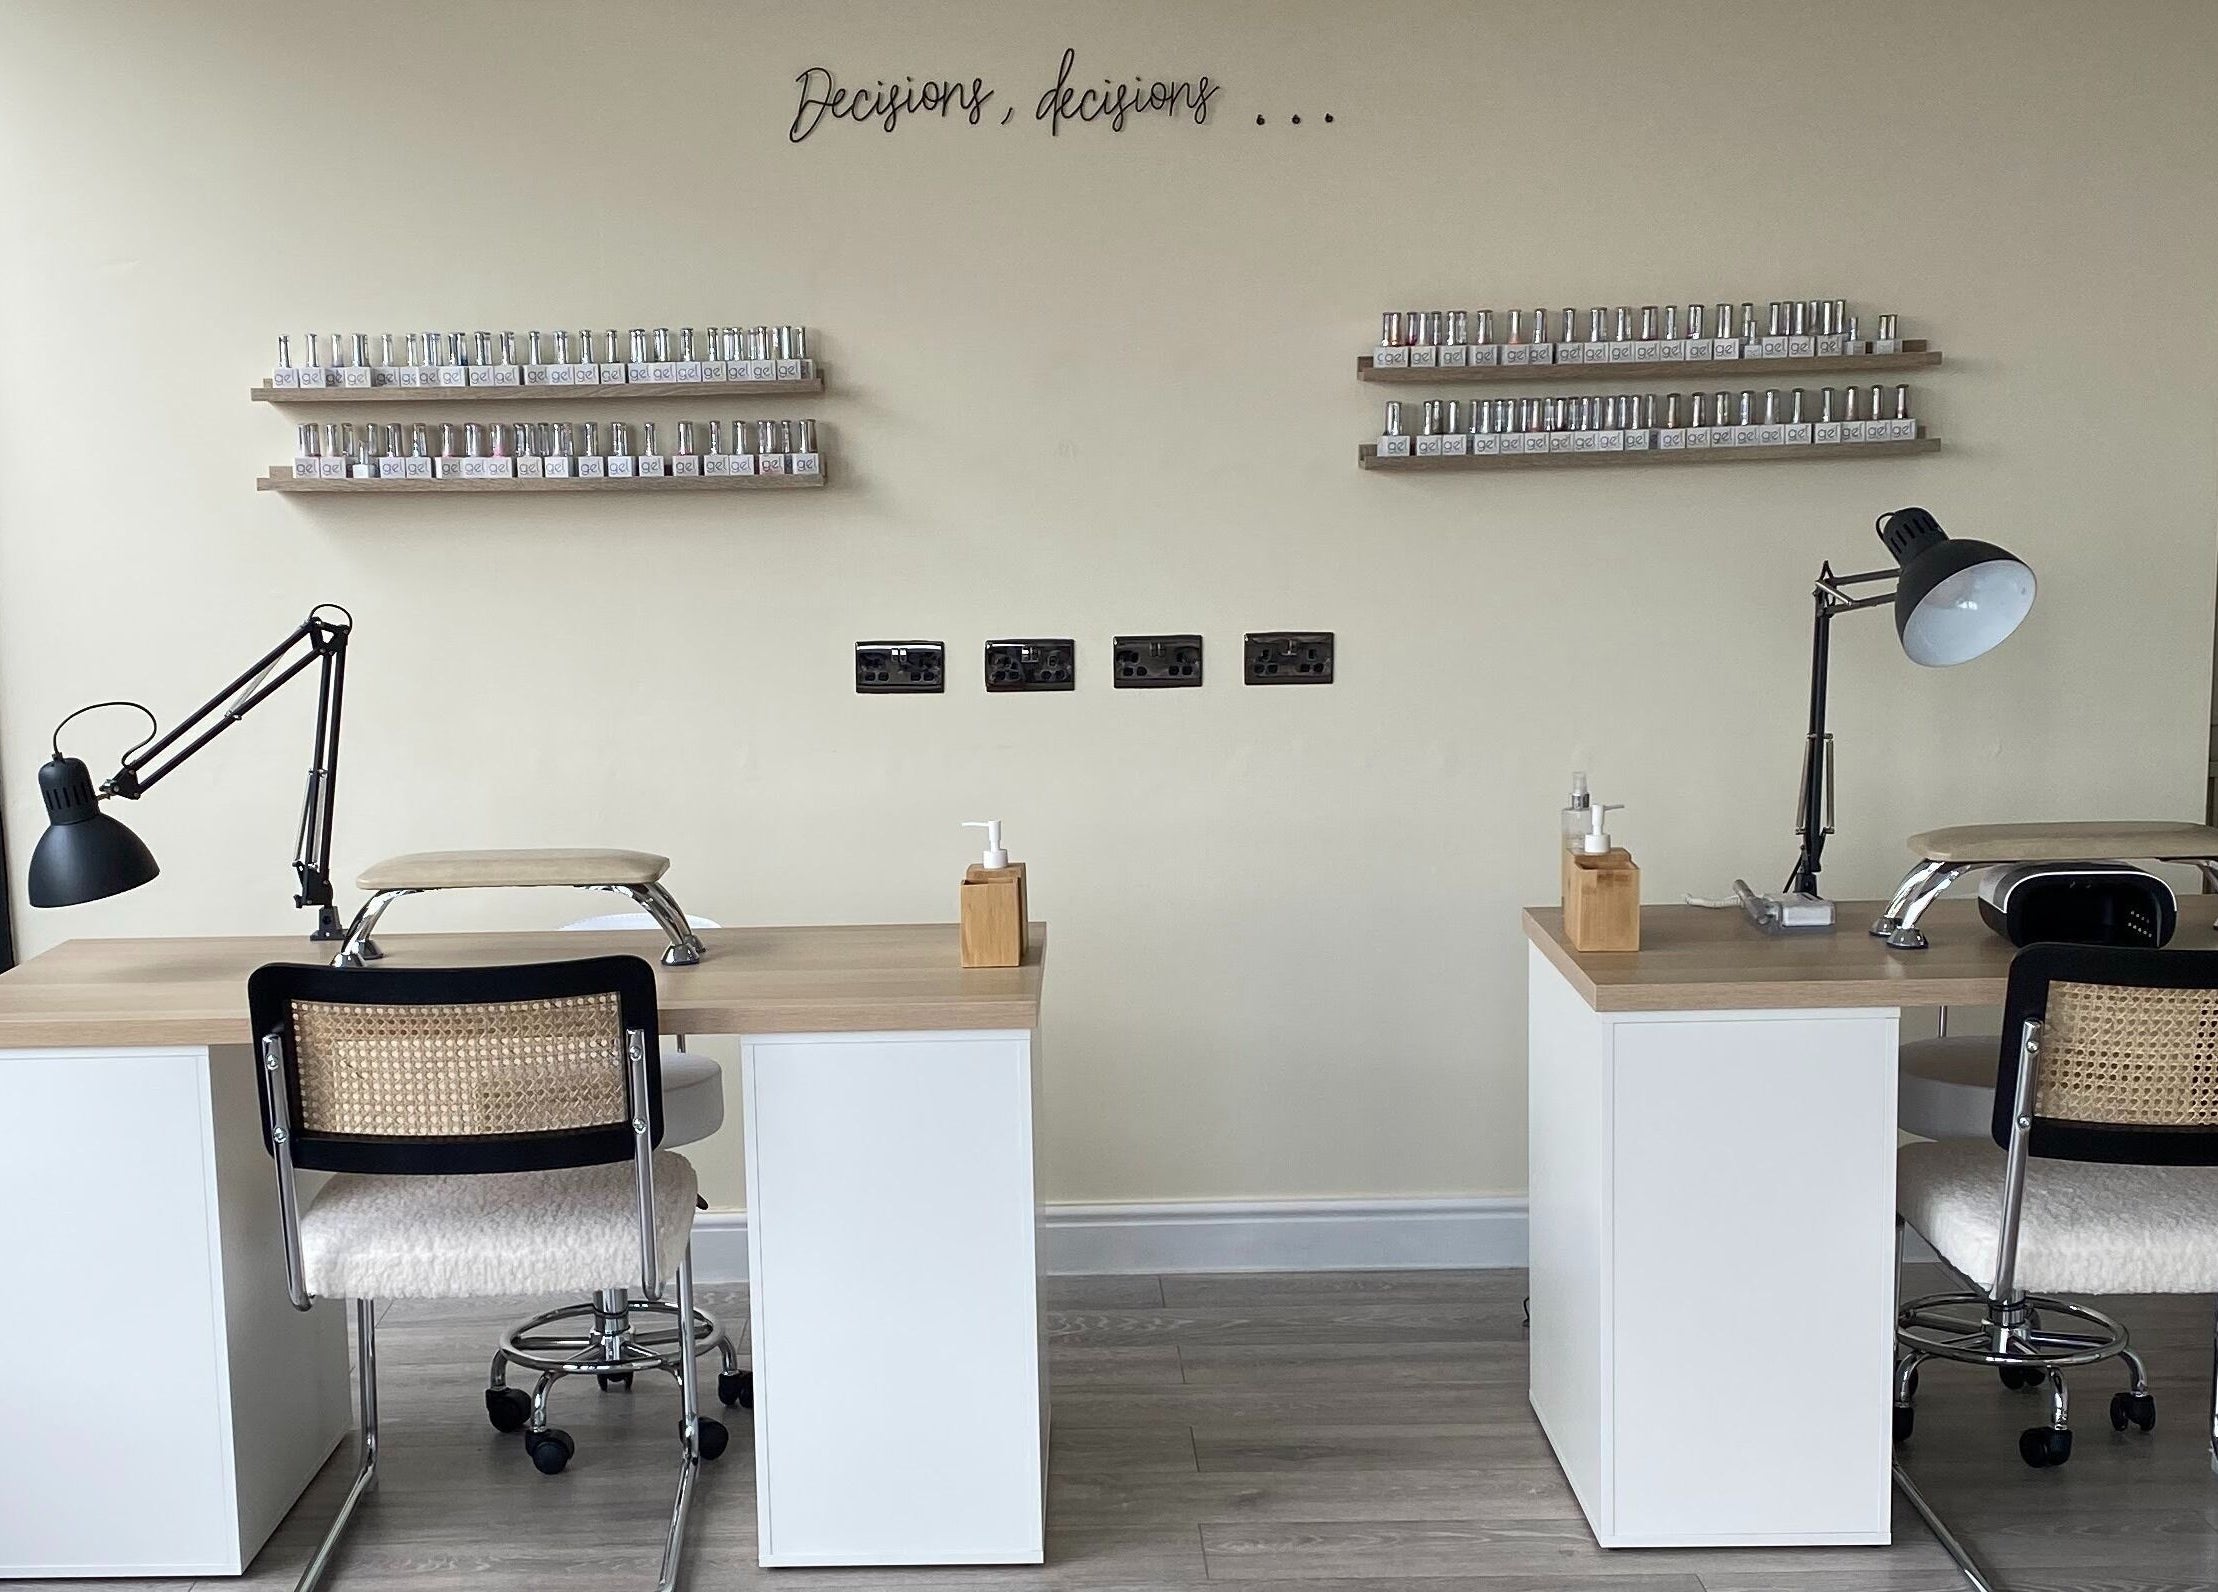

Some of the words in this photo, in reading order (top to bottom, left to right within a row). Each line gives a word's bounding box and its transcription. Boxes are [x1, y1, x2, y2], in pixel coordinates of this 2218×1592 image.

[1035, 48, 1220, 137] decisions
[1612, 344, 1631, 359] gel
[1637, 343, 1657, 358] gel
[1662, 342, 1682, 357] gel
[1690, 344, 1710, 357] gel
[1716, 341, 1735, 356] gel
[1765, 340, 1785, 354] gel
[1791, 340, 1810, 354] gel
[1820, 336, 1840, 353] gel
[1386, 349, 1405, 365] gel
[1412, 349, 1432, 364] gel
[1443, 348, 1463, 364] gel
[1475, 348, 1494, 364] gel
[1507, 348, 1526, 364] gel
[1530, 347, 1550, 362] gel
[1586, 346, 1606, 360] gel
[275, 369, 296, 385] gel
[420, 368, 439, 385] gel
[442, 369, 462, 385] gel
[470, 369, 490, 385] gel
[495, 369, 515, 385] gel
[527, 368, 548, 384] gel
[552, 368, 572, 383] gel
[577, 367, 596, 381] gel
[602, 367, 622, 382] gel
[630, 366, 650, 381] gel
[654, 366, 673, 381] gel
[678, 364, 698, 380] gel
[703, 364, 724, 379] gel
[729, 364, 748, 380] gel
[754, 362, 772, 378] gel
[778, 361, 798, 378] gel
[302, 370, 322, 385] gel
[347, 370, 368, 385] gel
[376, 370, 397, 386] gel
[1688, 430, 1708, 445] gel
[1713, 429, 1732, 444] gel
[1738, 429, 1757, 444] gel
[1761, 428, 1781, 442] gel
[1788, 425, 1808, 440] gel
[1818, 425, 1839, 440] gel
[1842, 425, 1861, 439] gel
[1868, 423, 1888, 438] gel
[1892, 422, 1912, 438] gel
[1419, 438, 1439, 452] gel
[1444, 438, 1463, 452] gel
[1477, 436, 1497, 451] gel
[1502, 436, 1522, 451] gel
[1527, 436, 1546, 451] gel
[1552, 436, 1571, 450] gel
[1576, 435, 1595, 449] gel
[1600, 433, 1620, 448] gel
[1627, 433, 1647, 448] gel
[1663, 431, 1683, 446] gel
[1388, 439, 1407, 454] gel
[297, 461, 317, 476] gel
[323, 461, 342, 475] gel
[383, 459, 403, 475] gel
[408, 459, 428, 475] gel
[442, 460, 461, 475] gel
[465, 460, 485, 475] gel
[489, 459, 509, 475] gel
[519, 460, 539, 475] gel
[546, 462, 565, 476] gel
[581, 462, 601, 476] gel
[610, 460, 630, 474] gel
[641, 459, 661, 474] gel
[676, 461, 695, 474] gel
[706, 459, 726, 474] gel
[731, 459, 750, 473] gel
[762, 458, 782, 473] gel
[797, 458, 817, 471] gel
